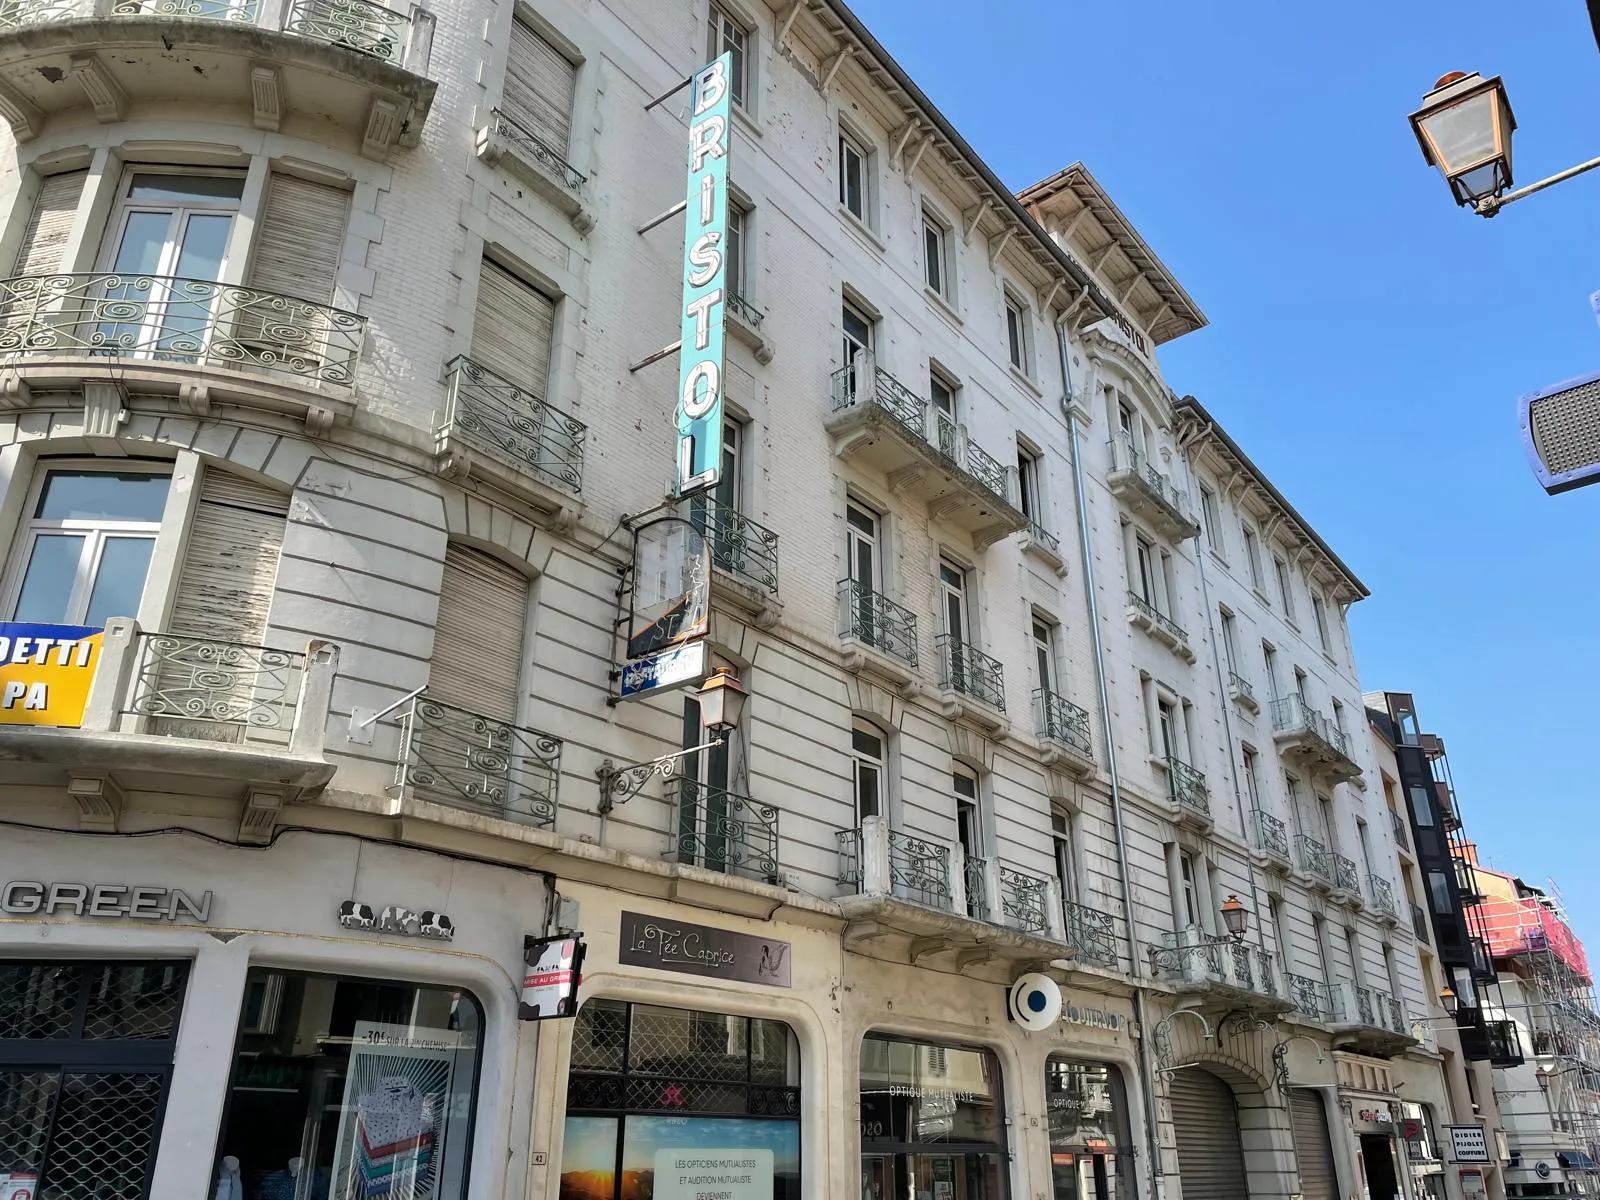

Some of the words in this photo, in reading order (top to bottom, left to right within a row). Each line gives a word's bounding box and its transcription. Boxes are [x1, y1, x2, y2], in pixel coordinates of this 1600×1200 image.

[681, 60, 727, 493] BRISTOL
[2, 681, 48, 710] PA
[1, 881, 213, 922] GREEN
[630, 925, 651, 953] La
[684, 933, 735, 966] Caprice
[889, 1085, 925, 1098] OPTIQUE
[928, 1087, 973, 1102] MUTUALISTE
[1053, 1098, 1079, 1109] OPTIQUE
[675, 1160, 686, 1169] LES
[687, 1160, 718, 1169] OPTICIENS
[719, 1160, 756, 1168] MUTUALISTES
[679, 1176, 687, 1185] ET
[688, 1176, 717, 1184] AUDITION
[718, 1176, 751, 1184] MUTUALISTE
